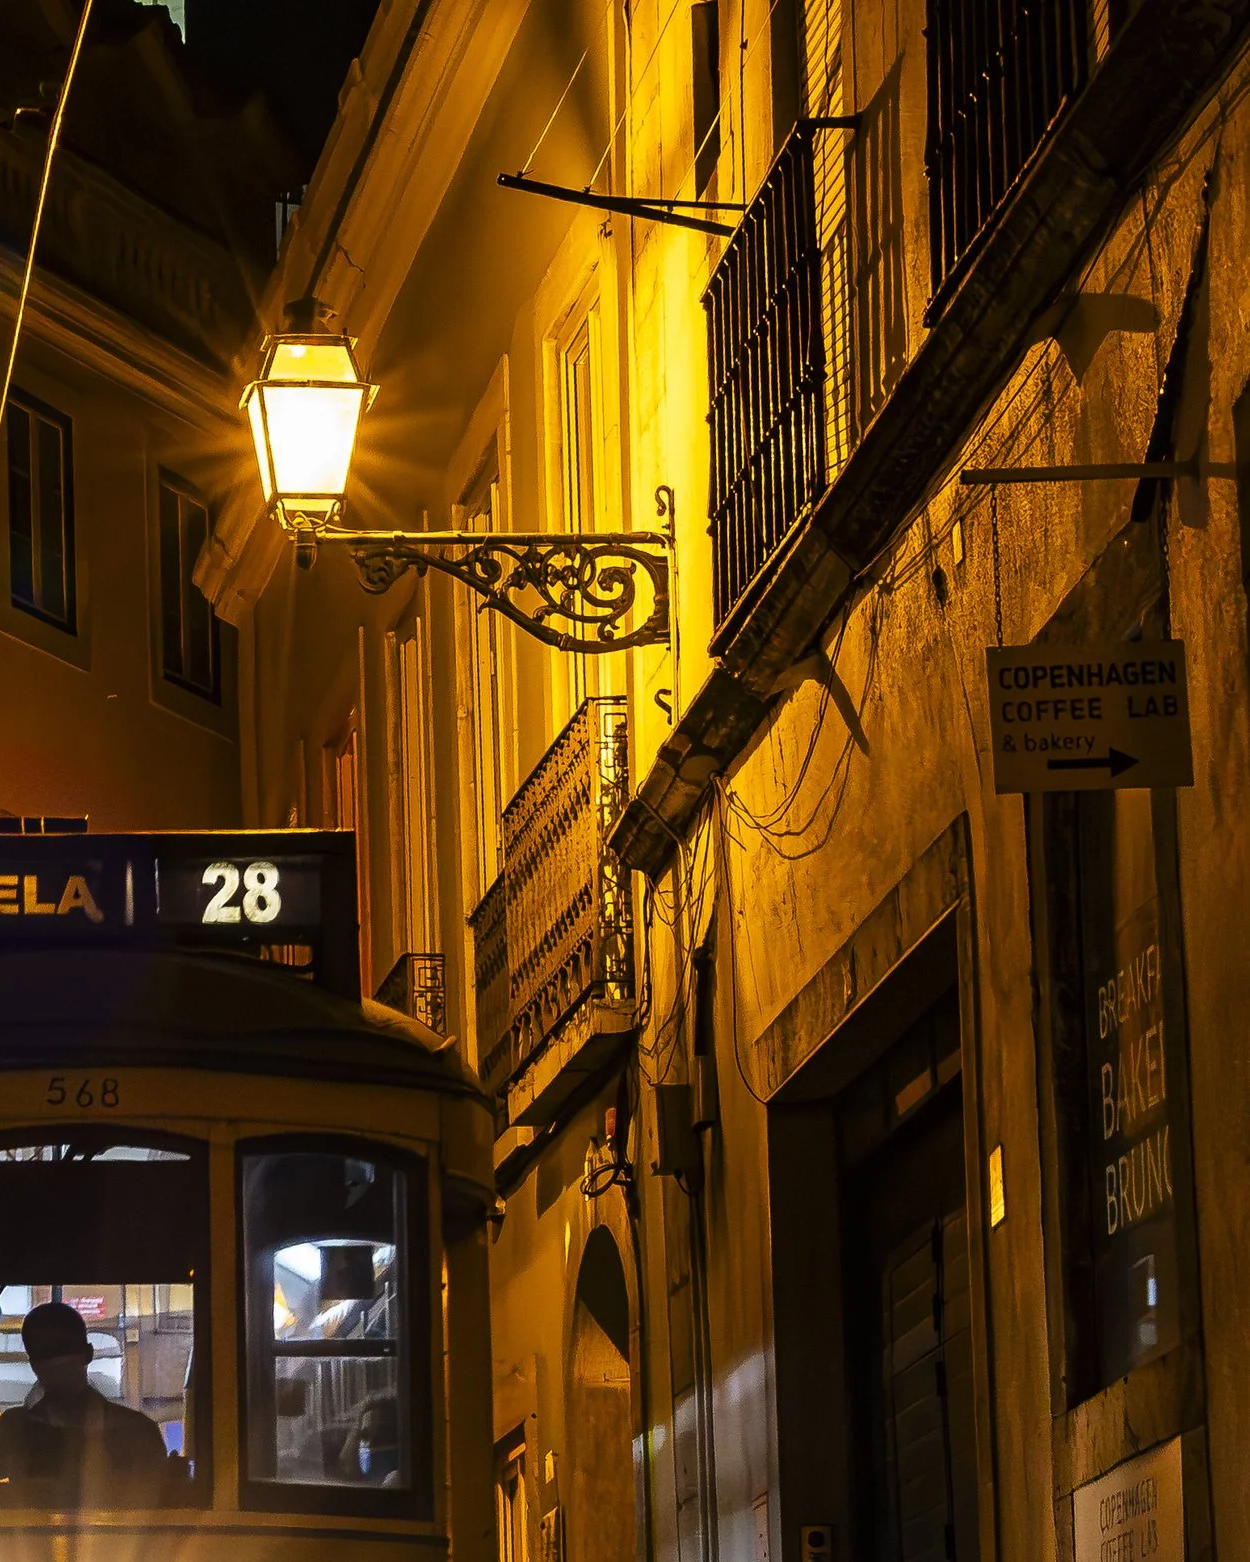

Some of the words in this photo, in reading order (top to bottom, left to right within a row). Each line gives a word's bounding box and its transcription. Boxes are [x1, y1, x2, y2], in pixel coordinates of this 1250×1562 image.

[1000, 661, 1176, 690] COPENHAGEN
[1002, 698, 1102, 723] COFFEE
[1128, 695, 1178, 718] LAB
[1002, 734, 1016, 752] &
[1024, 733, 1095, 754] bakery
[201, 861, 282, 924] 28
[47, 1077, 119, 1108] 568
[1101, 1019, 1166, 1140] BAKE
